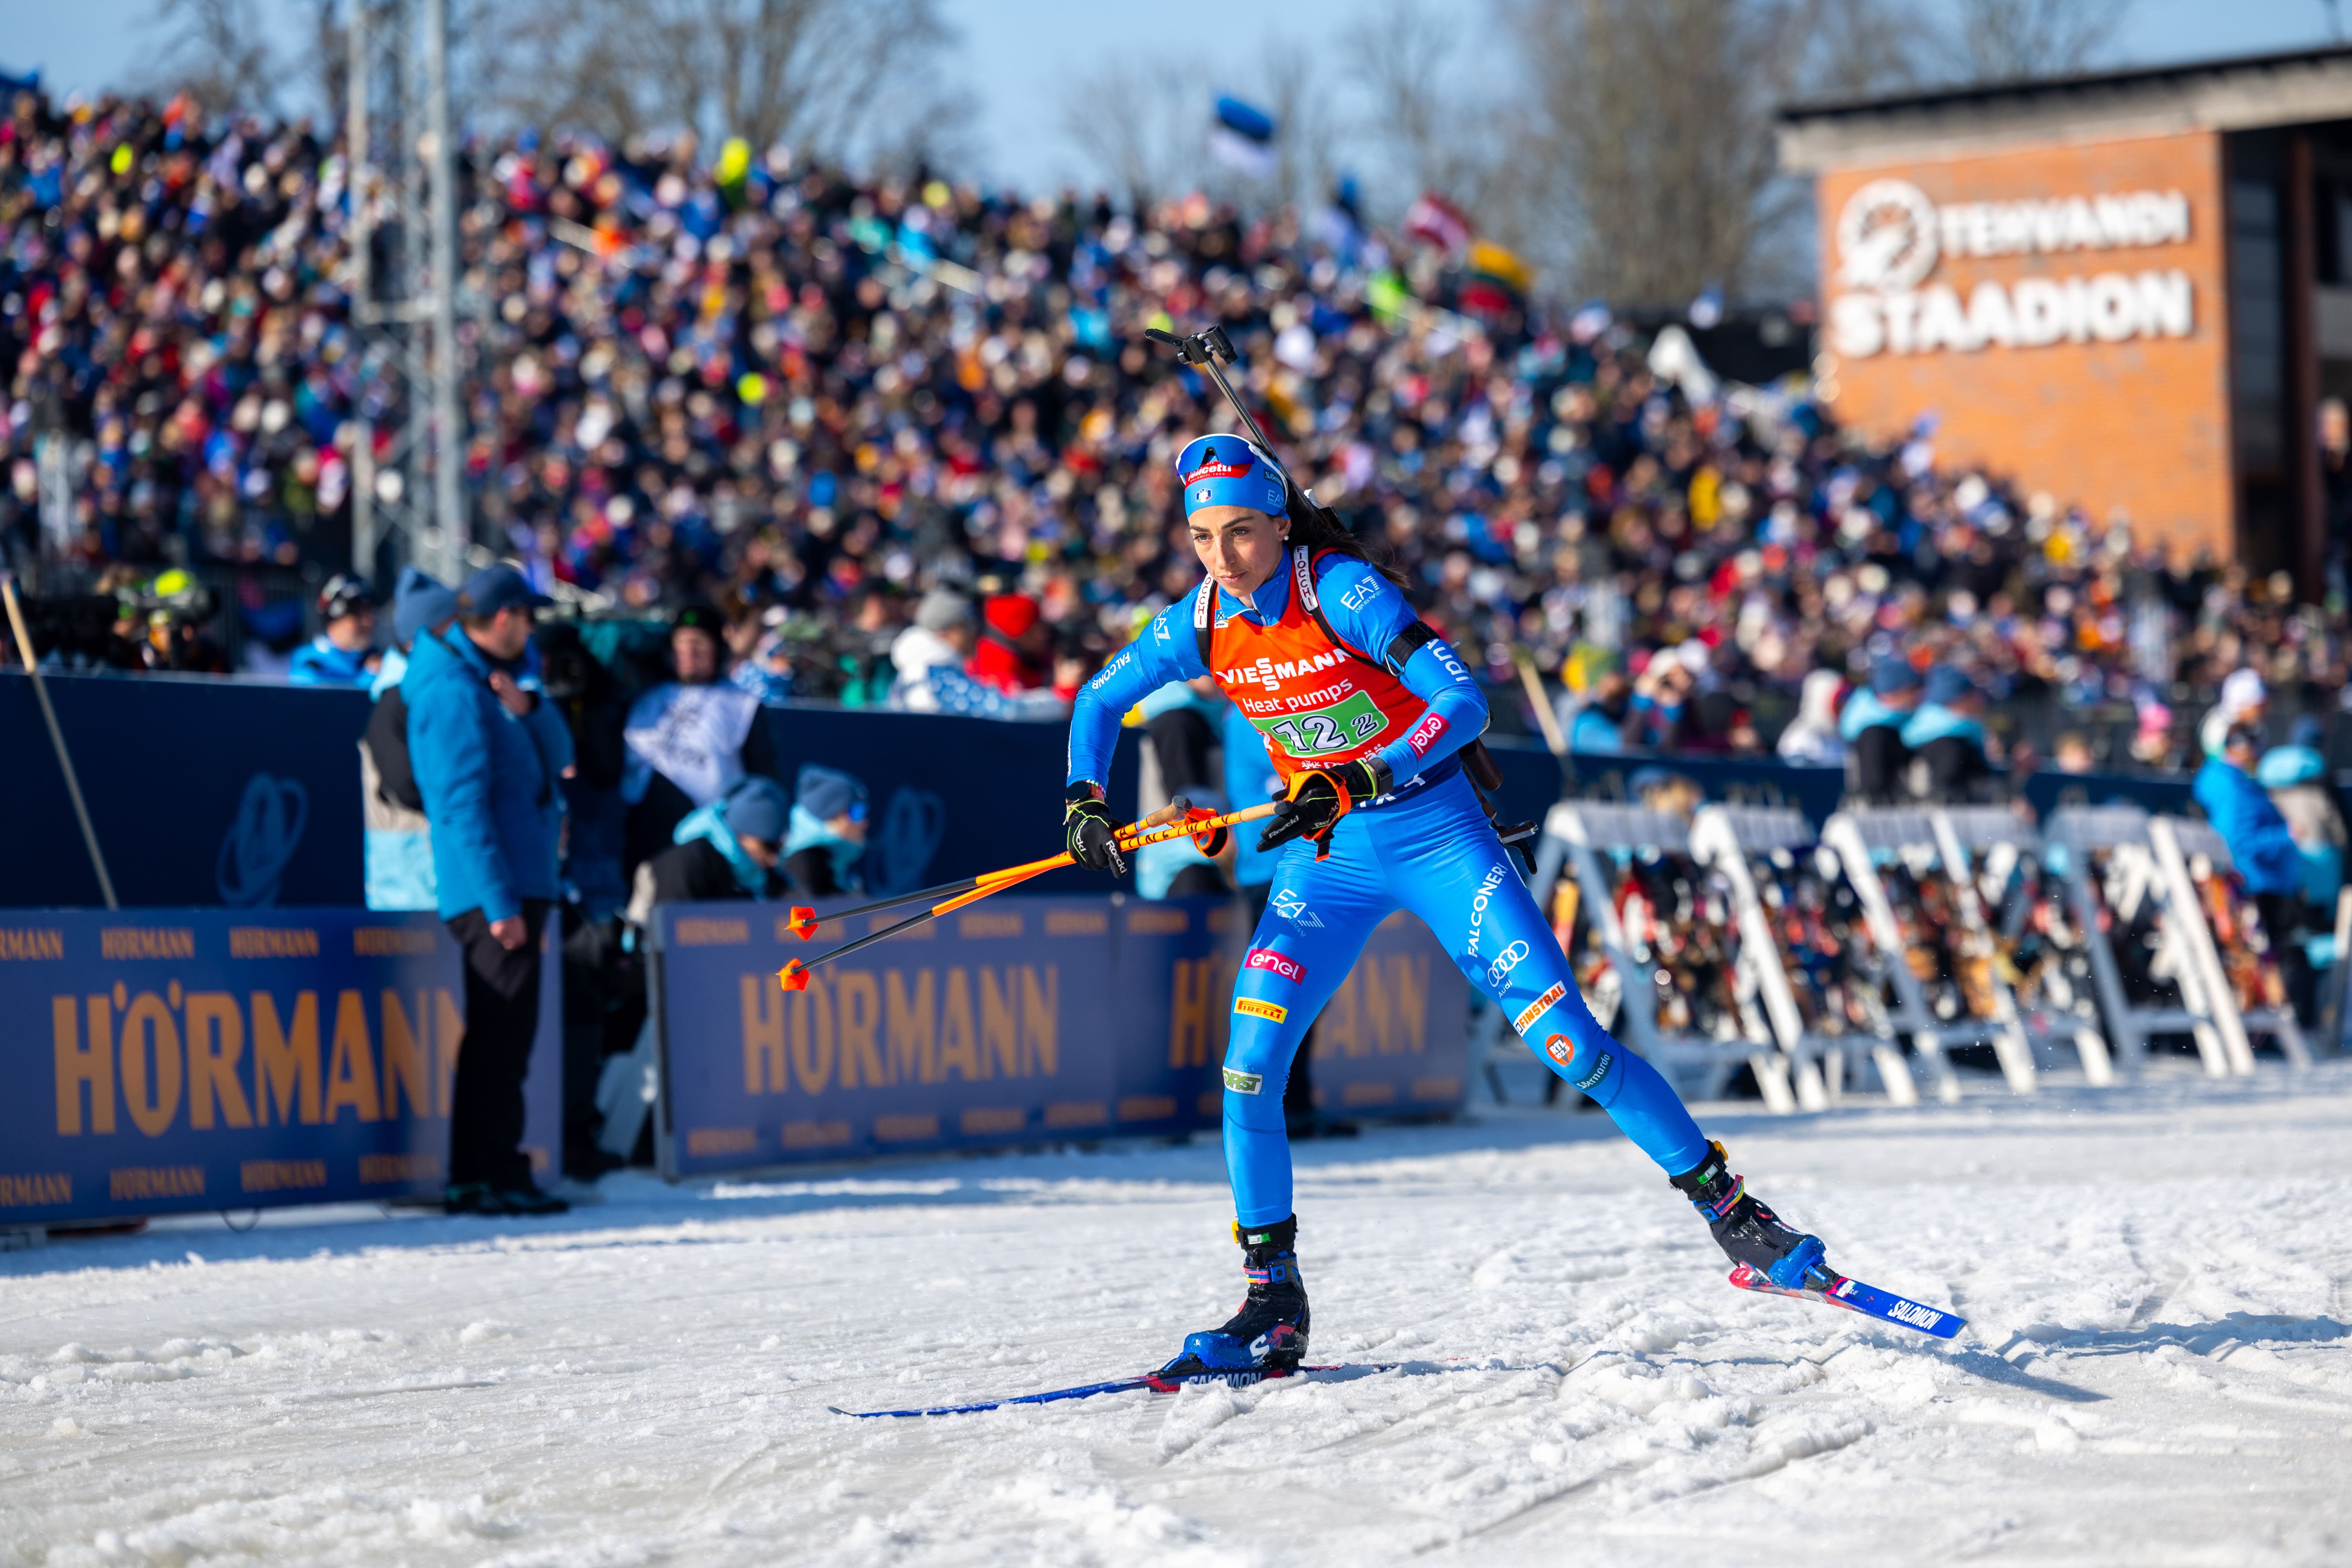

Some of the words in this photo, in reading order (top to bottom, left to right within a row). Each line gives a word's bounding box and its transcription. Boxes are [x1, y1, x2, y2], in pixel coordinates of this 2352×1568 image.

[1830, 268, 2194, 358] STAADION
[1296, 546, 1313, 607] FIOCCHI
[1340, 575, 1380, 611] EA7
[1198, 577, 1212, 625] OCCHI
[1426, 639, 1470, 682] Audi
[1242, 697, 1284, 713] Heat
[1286, 678, 1353, 711] pumps
[1270, 715, 1350, 753] 12
[1351, 712, 1379, 739] 2
[1411, 717, 1442, 754] enel
[1271, 888, 1325, 928] EA7
[1468, 862, 1508, 958] FALCONERI
[1250, 953, 1299, 980] enel
[1498, 979, 1513, 999] Audi
[1519, 985, 1565, 1029] FINSTRAL
[1237, 1000, 1283, 1020] PIRELLI
[1549, 1038, 1566, 1055] RTL
[1555, 1044, 1570, 1060] 102.5
[1222, 1069, 1261, 1091] ORST
[1887, 1299, 1944, 1330] SALOMON
